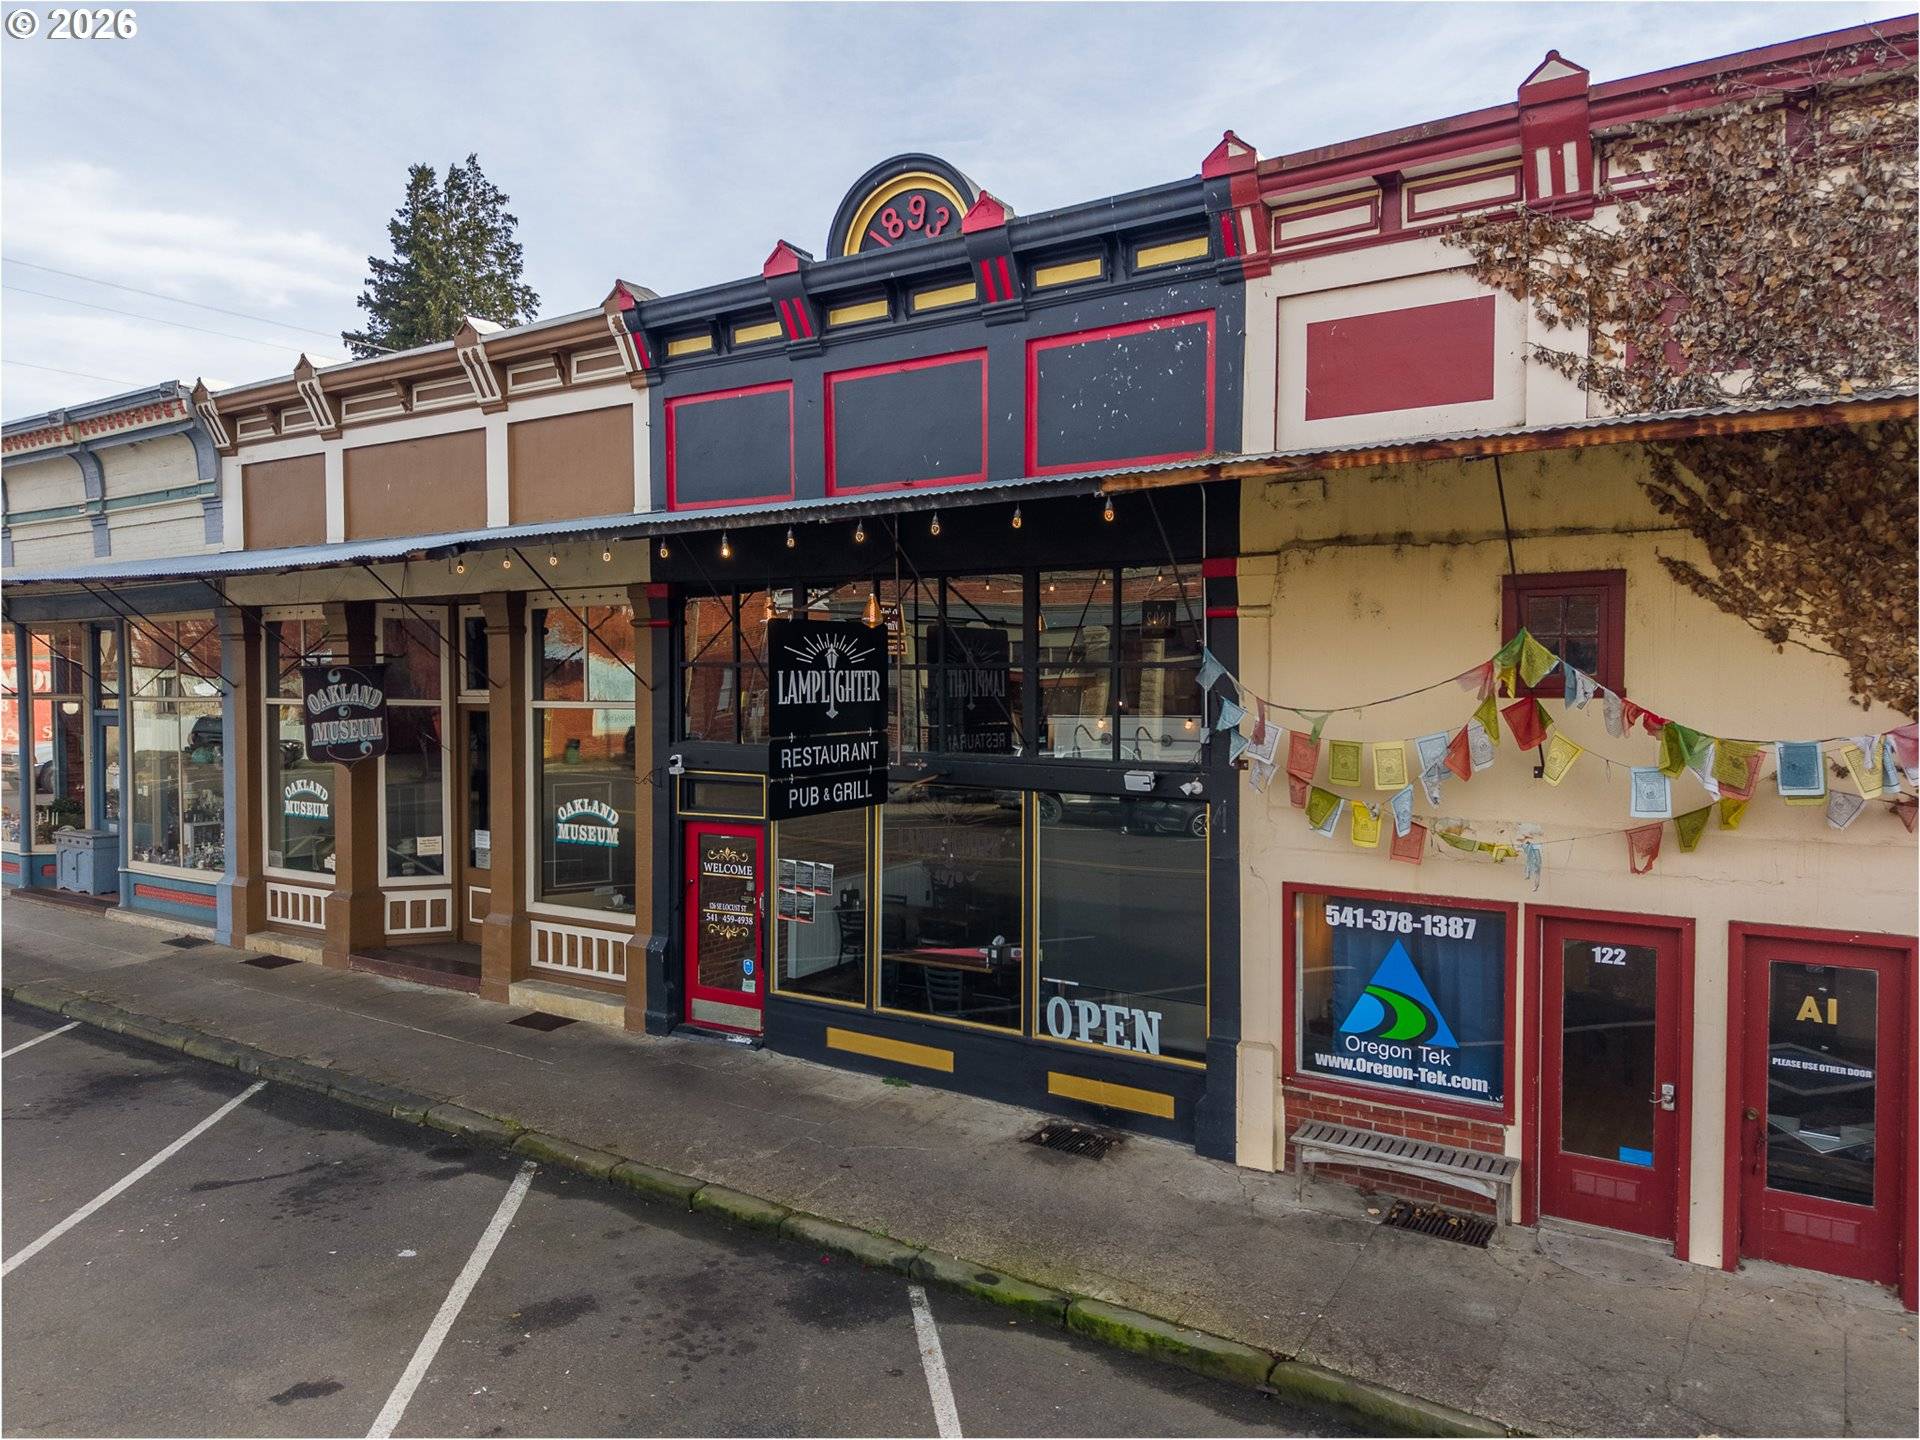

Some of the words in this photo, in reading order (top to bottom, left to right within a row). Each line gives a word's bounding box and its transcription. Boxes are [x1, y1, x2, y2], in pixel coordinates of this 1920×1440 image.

[868, 194, 950, 248] 1893
[306, 683, 383, 715] OAKLAND
[777, 668, 881, 706] LAMPLIGHTER
[311, 717, 384, 746] MUSEUM
[781, 741, 879, 769] RESTAURANT
[284, 779, 329, 801] OAKLAND
[788, 785, 820, 809] PUB
[823, 787, 831, 801] &
[832, 779, 873, 802] GRILL
[284, 800, 329, 817] MUSEUM
[557, 798, 620, 826] OAKLAND
[557, 823, 620, 846] MUSEUM
[703, 862, 753, 876] WELCOME
[706, 912, 718, 922] 541
[722, 914, 753, 925] 459-4938
[1325, 904, 1477, 940] 541-378-1387
[1591, 946, 1627, 966] 122
[1046, 996, 1162, 1056] OPEN
[1345, 1035, 1412, 1060] Oregon
[1418, 1046, 1452, 1067] Tek
[1314, 1052, 1489, 1093] www.Oregon-Tek.com
[1771, 1057, 1801, 1069] PLEASE
[1801, 1061, 1819, 1072] USE
[1818, 1064, 1847, 1075] OTHER
[1847, 1068, 1873, 1079] DOOR
